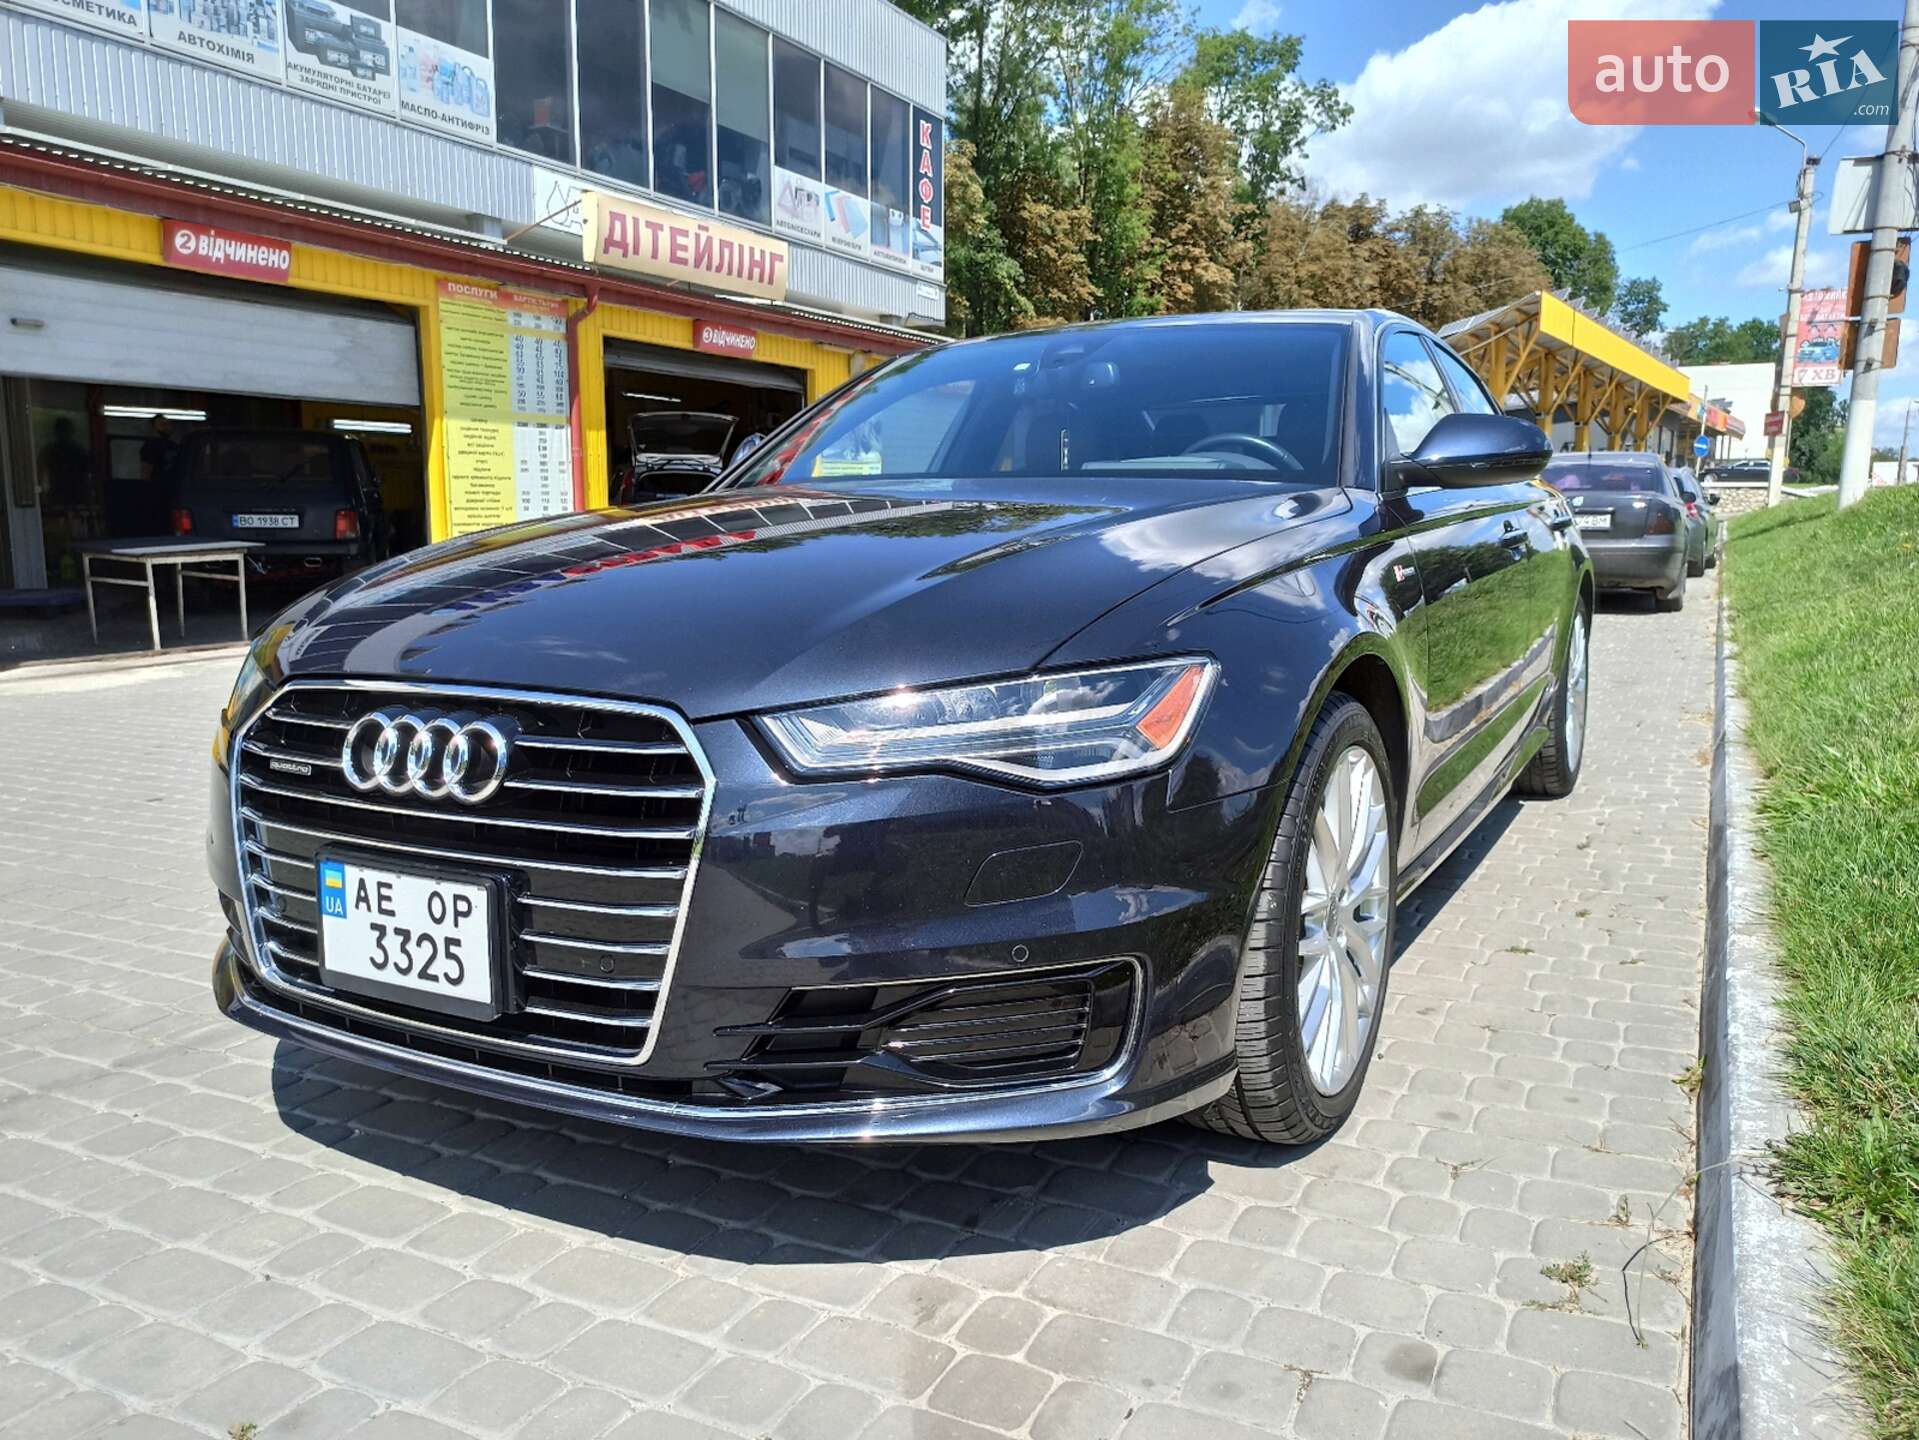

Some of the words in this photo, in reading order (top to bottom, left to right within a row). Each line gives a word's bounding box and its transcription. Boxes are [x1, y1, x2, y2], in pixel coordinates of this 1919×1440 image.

[53, 0, 138, 26] СМЕТИКА
[177, 30, 255, 64] АВТОХІМІЯ
[287, 62, 354, 88] АКУМУЛЯТОРНІ
[299, 74, 337, 92] ЗАРЯДНІ
[918, 119, 934, 232] КАФЕ
[177, 231, 193, 252] 2
[198, 230, 290, 270] відчинено
[603, 210, 785, 287] ДІТЕЙЛІНГ
[447, 282, 498, 300] ПОСЛУГИ
[712, 326, 756, 350] відчинено
[325, 895, 344, 915] UA
[355, 877, 396, 917] AE
[427, 890, 472, 928] OP
[369, 922, 465, 986] 3325
